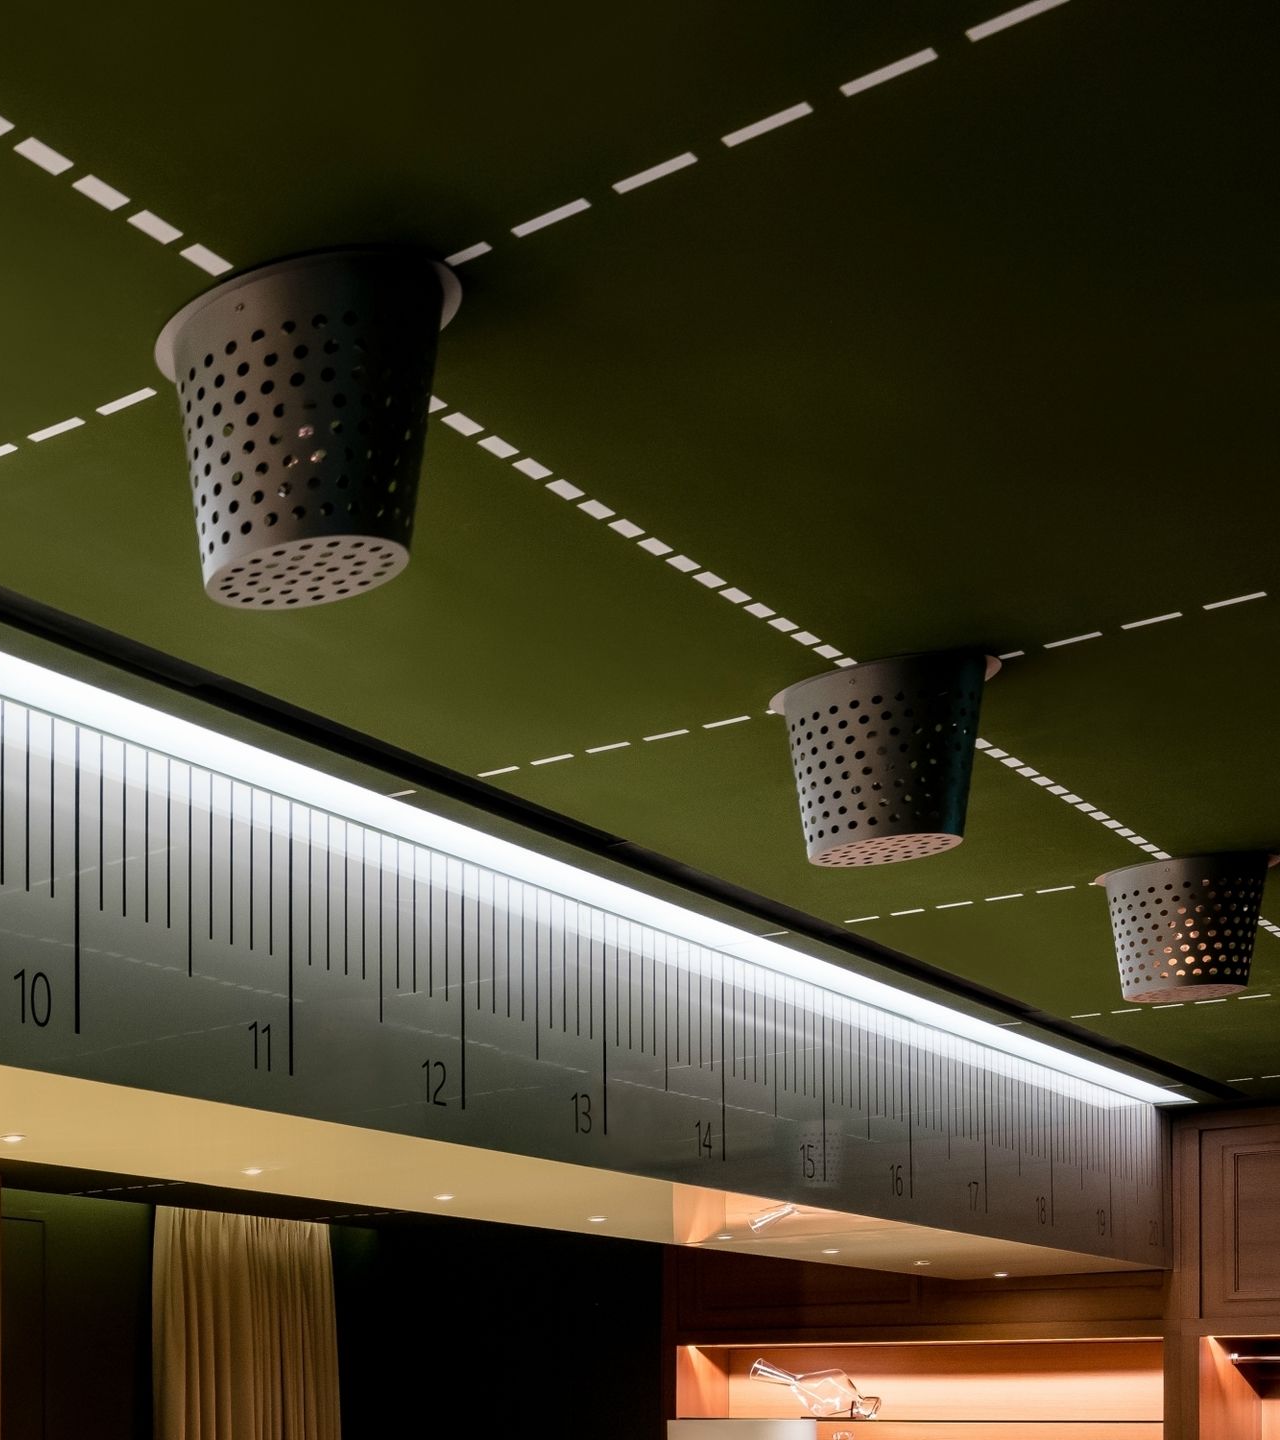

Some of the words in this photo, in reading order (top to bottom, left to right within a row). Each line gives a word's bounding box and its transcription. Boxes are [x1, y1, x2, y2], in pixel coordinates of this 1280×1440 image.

[14, 968, 52, 1027] 10
[248, 1021, 271, 1072] 11
[421, 1059, 447, 1106] 12
[571, 1091, 592, 1134] 13
[695, 1120, 712, 1159] 14
[800, 1143, 815, 1179] 15
[890, 1164, 903, 1197] 16
[968, 1181, 979, 1211] 17
[1036, 1196, 1046, 1224] 18
[1096, 1209, 1105, 1236] 19
